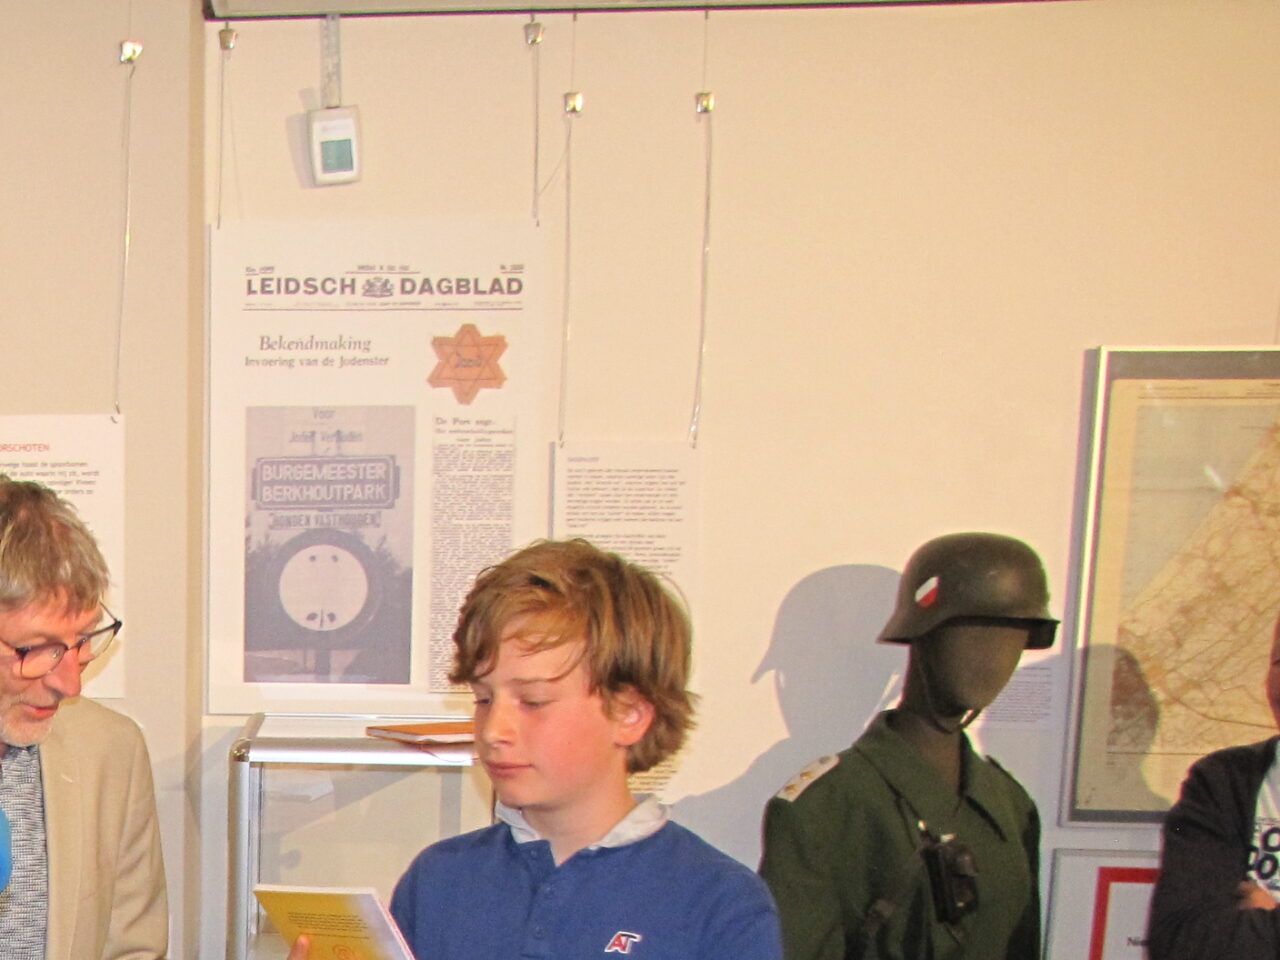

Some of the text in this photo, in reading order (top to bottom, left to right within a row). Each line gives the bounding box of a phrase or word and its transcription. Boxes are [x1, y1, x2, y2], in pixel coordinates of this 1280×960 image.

[246, 278, 522, 296] LEIDSCH DAGBLAD
[259, 335, 372, 352] Bekendmaking
[245, 356, 389, 368] Invoering van de Jodenster
[262, 464, 386, 481] BURGEMEESTER
[262, 484, 386, 502] BERKHOUTPARK
